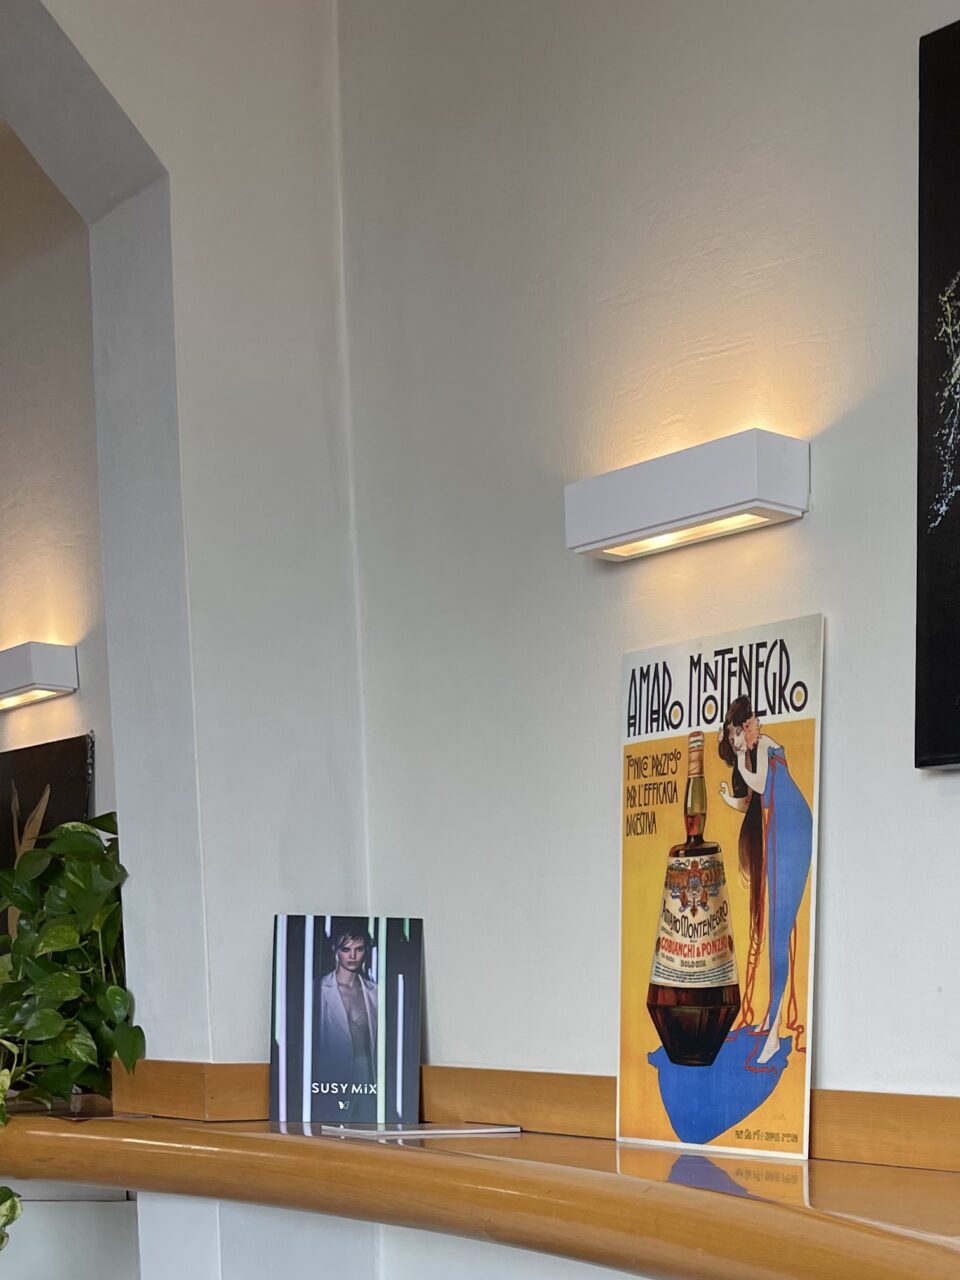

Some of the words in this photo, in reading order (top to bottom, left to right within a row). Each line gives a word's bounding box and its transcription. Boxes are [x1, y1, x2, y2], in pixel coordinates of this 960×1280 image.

[627, 661, 684, 738] AMARO
[688, 638, 809, 728] MONTENEGRO
[312, 1082, 348, 1094] SUSY
